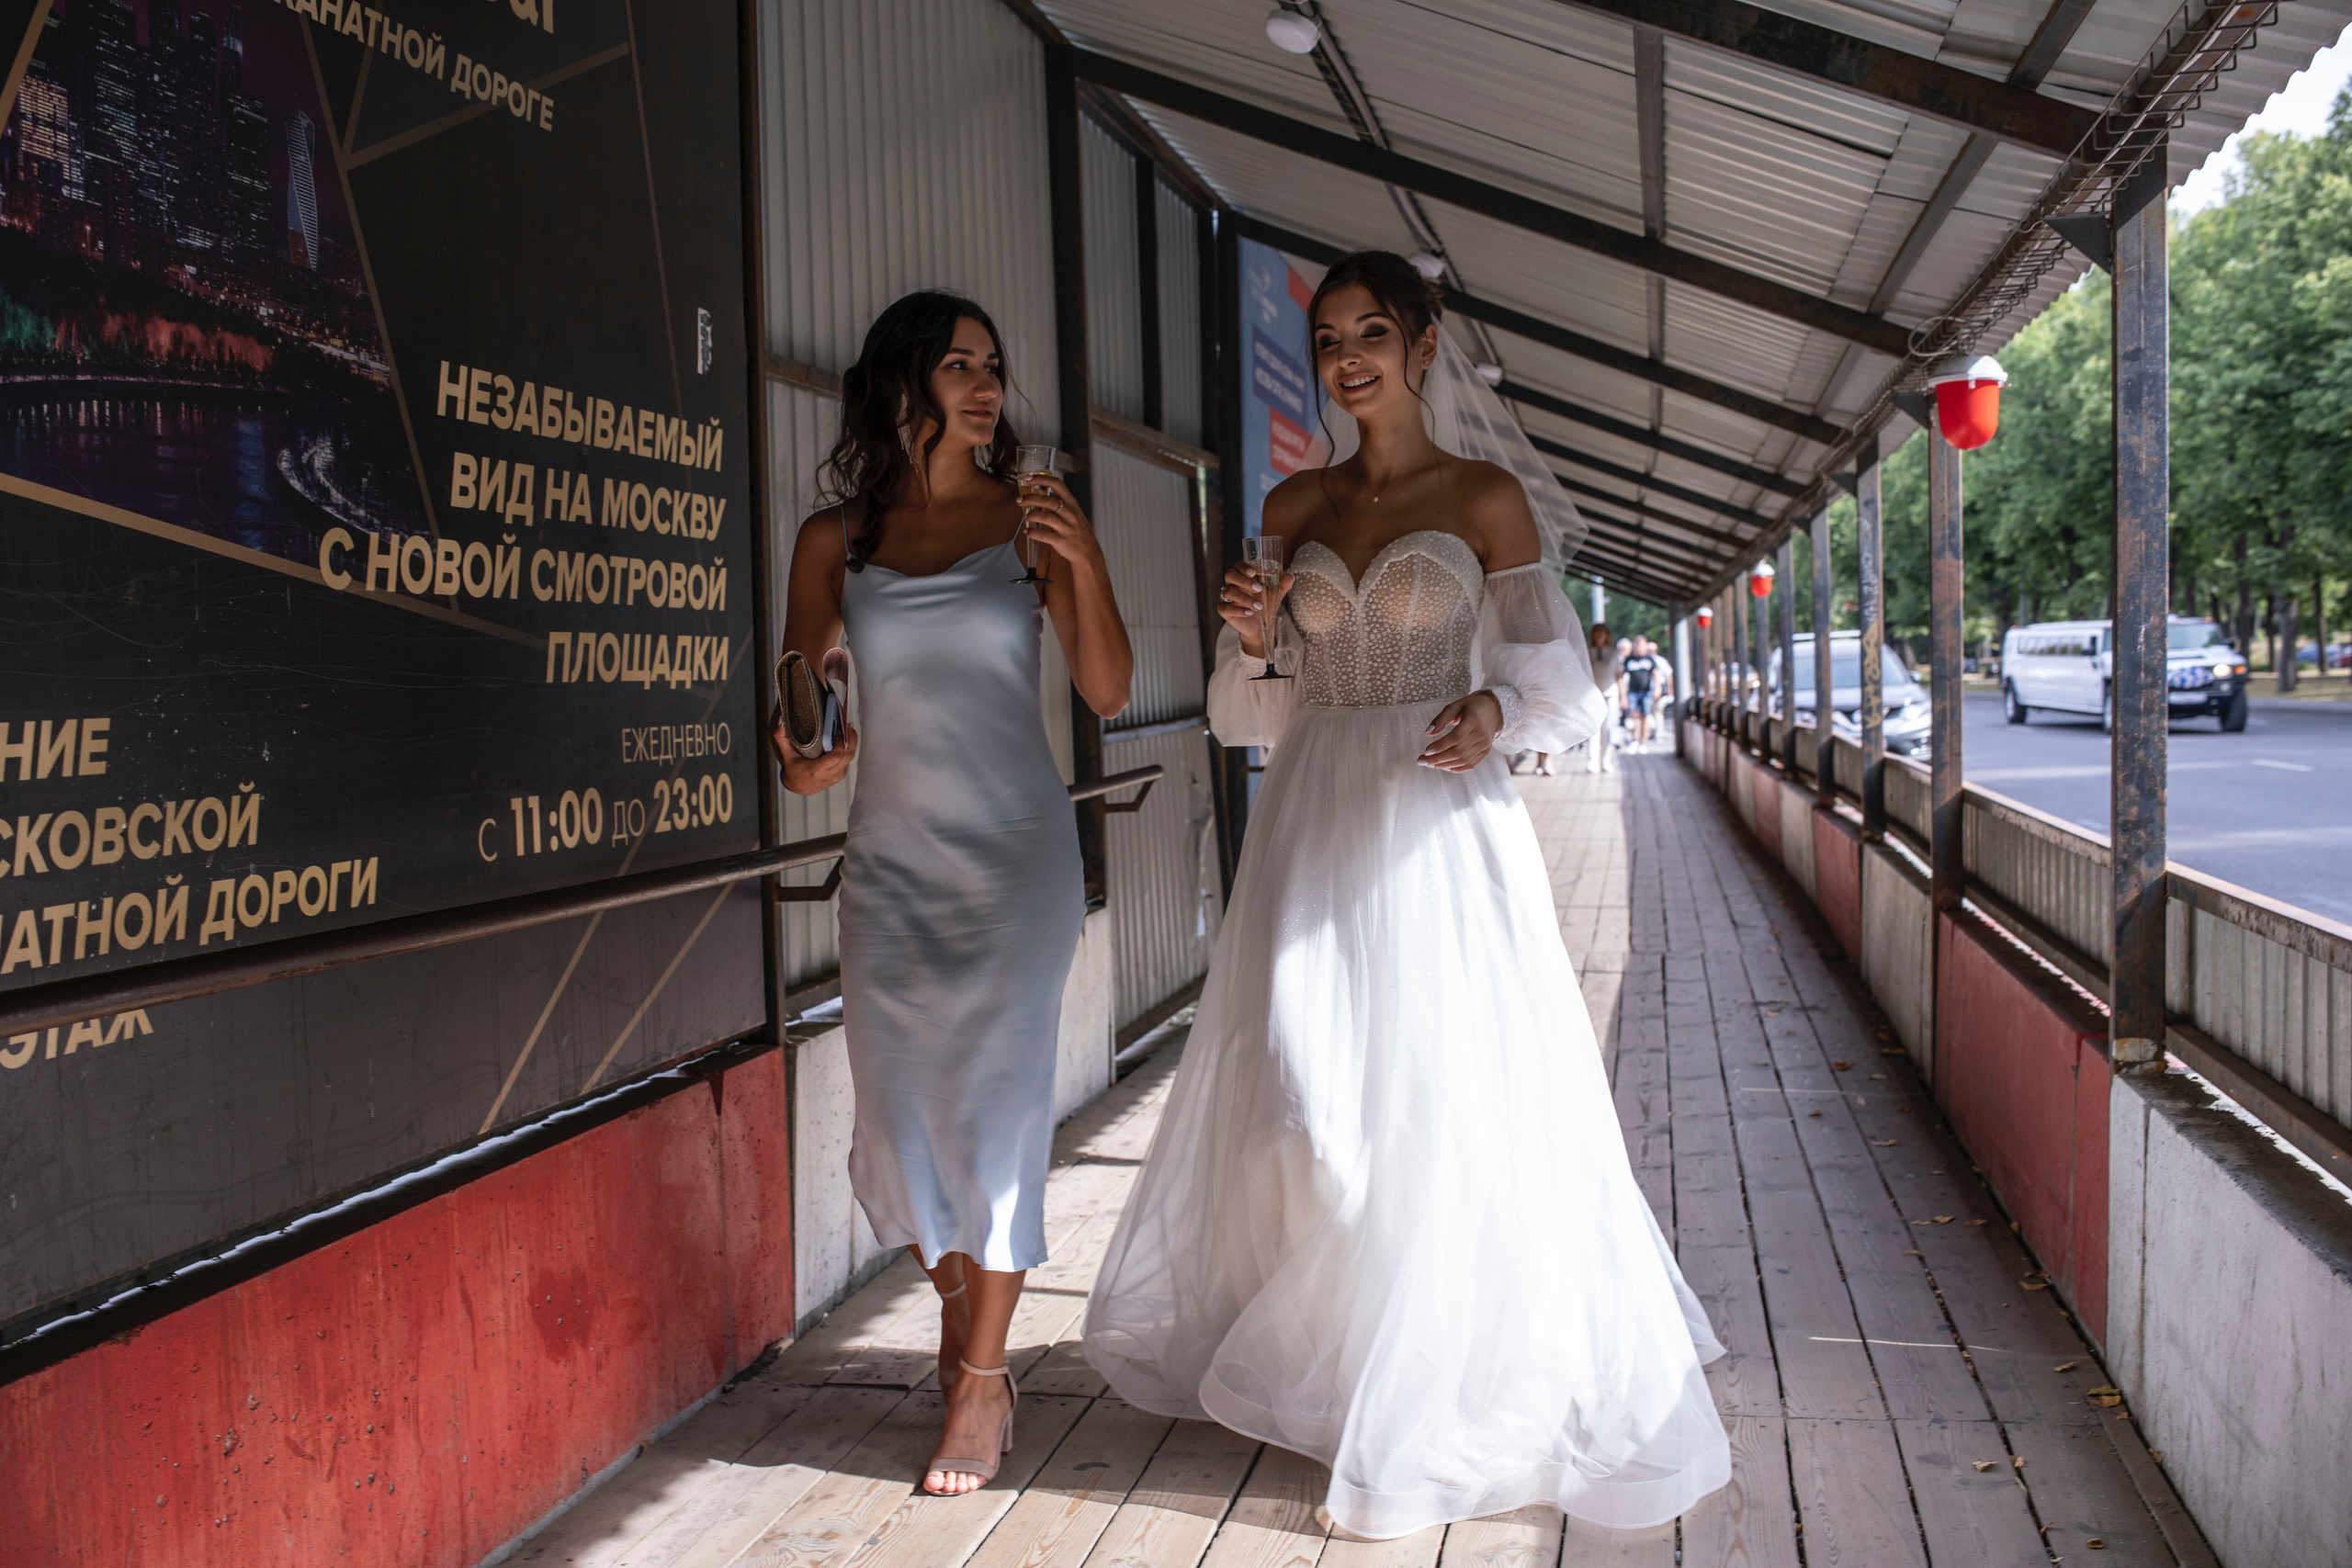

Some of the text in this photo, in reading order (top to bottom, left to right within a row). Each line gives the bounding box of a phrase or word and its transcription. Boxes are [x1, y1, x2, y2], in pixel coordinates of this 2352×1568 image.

[450, 53, 554, 132] ДОРОГЕ
[436, 360, 724, 472] НЕЗАБЫВАЕМЫЙ
[450, 451, 727, 541] ВИД НА МОСКВУ
[319, 526, 728, 612] С НОВОЙ СМОТРОВОЙ
[546, 631, 730, 691] ПЛОЩАДКИ
[621, 722, 731, 767] ЕЖЕДНЕВНО
[478, 773, 733, 862] С 11:00 ДО 23:00
[0, 856, 379, 975] АТНОЙ ДОРОГИ
